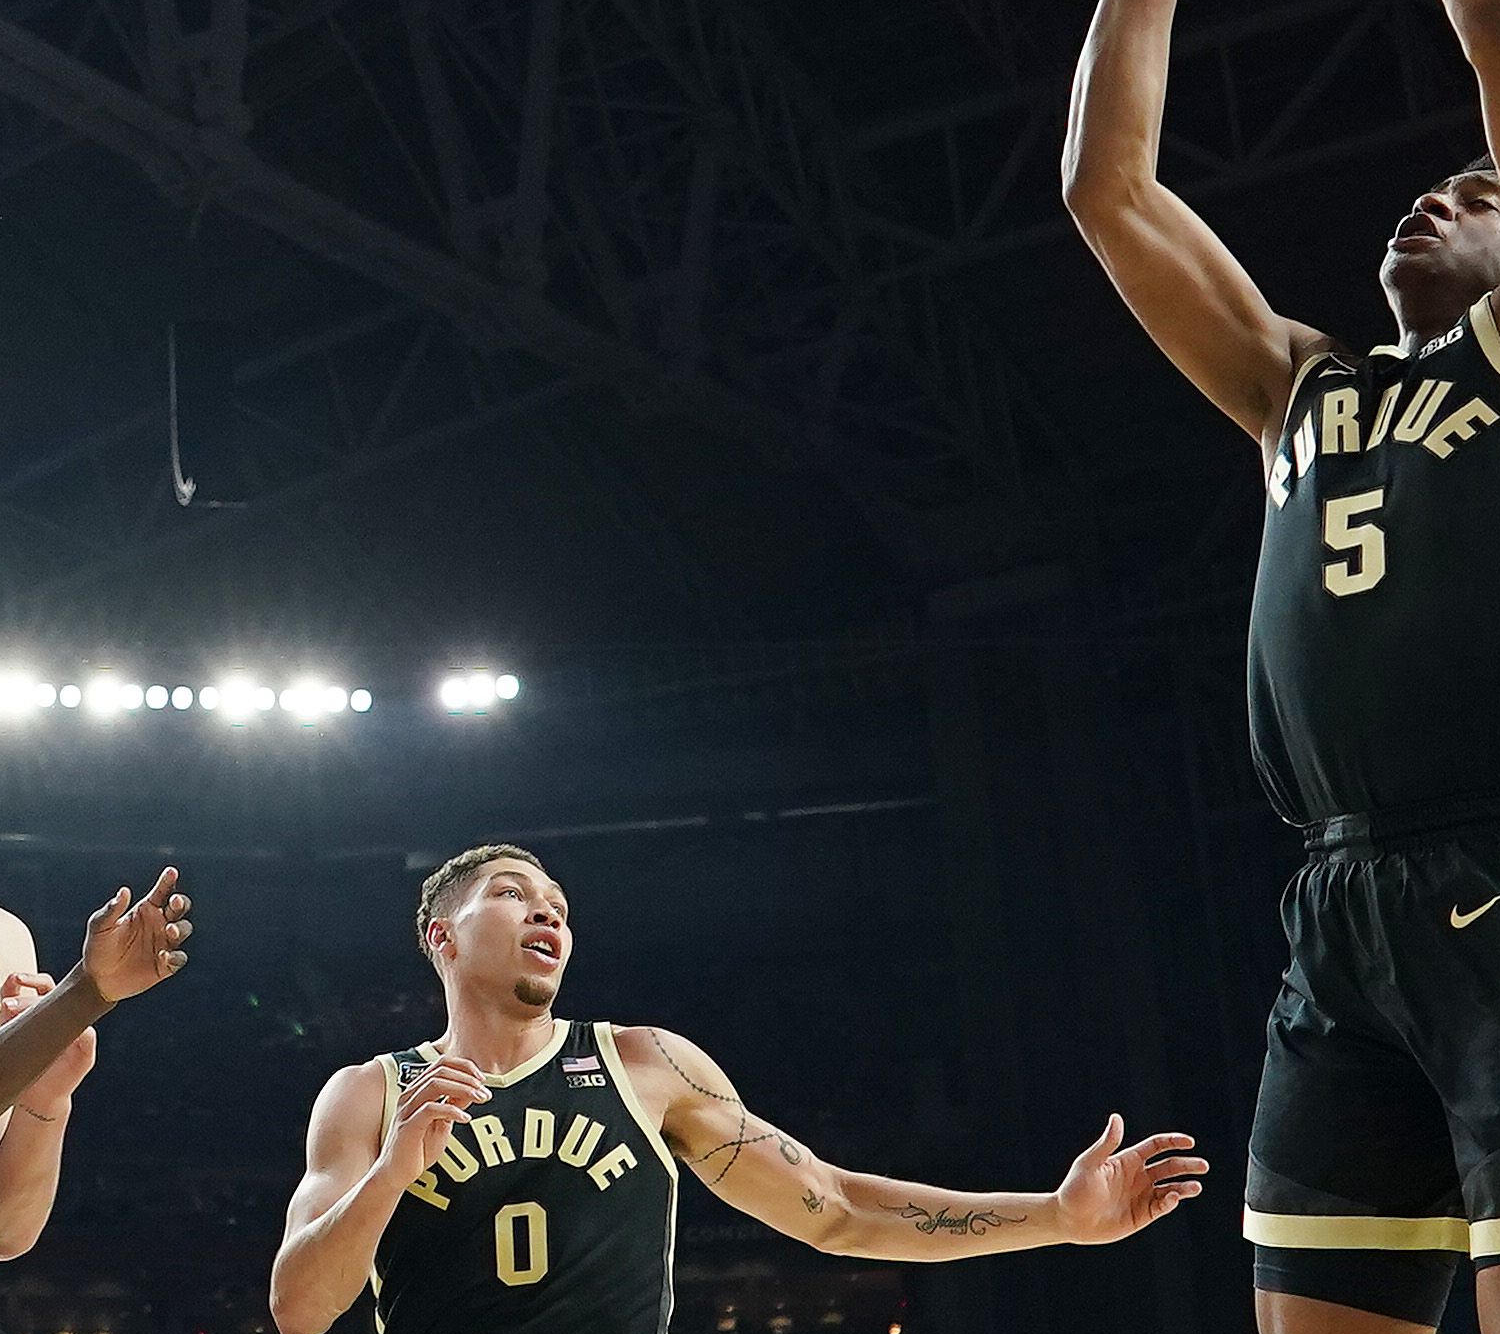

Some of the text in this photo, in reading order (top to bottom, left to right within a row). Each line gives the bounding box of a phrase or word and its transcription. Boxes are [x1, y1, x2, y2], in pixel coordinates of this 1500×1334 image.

[1322, 486, 1386, 598] 5
[404, 1107, 639, 1211] PURDUE
[495, 1202, 549, 1287] 0
